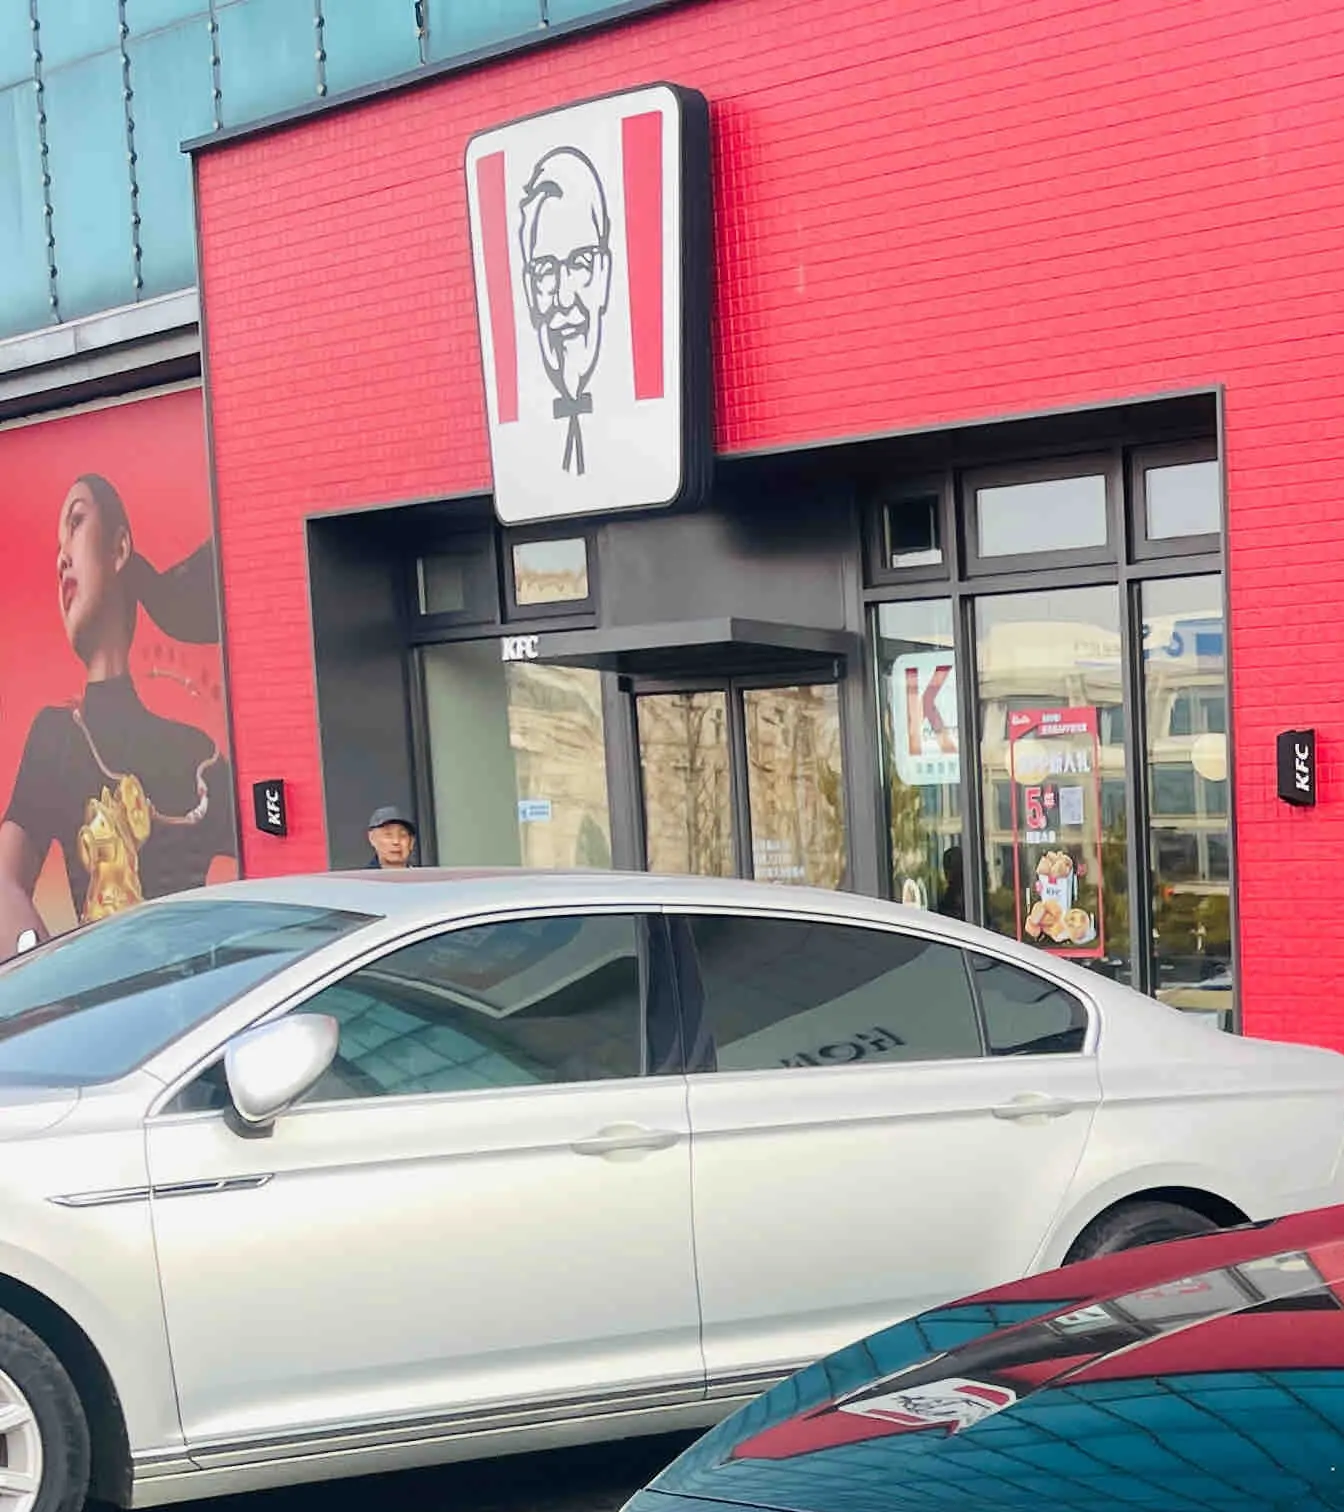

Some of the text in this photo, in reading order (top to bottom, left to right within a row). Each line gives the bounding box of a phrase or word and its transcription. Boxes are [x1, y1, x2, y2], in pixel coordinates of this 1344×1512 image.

[501, 635, 539, 661] KFC
[1294, 743, 1310, 792] KFC
[266, 789, 281, 825] KFC
